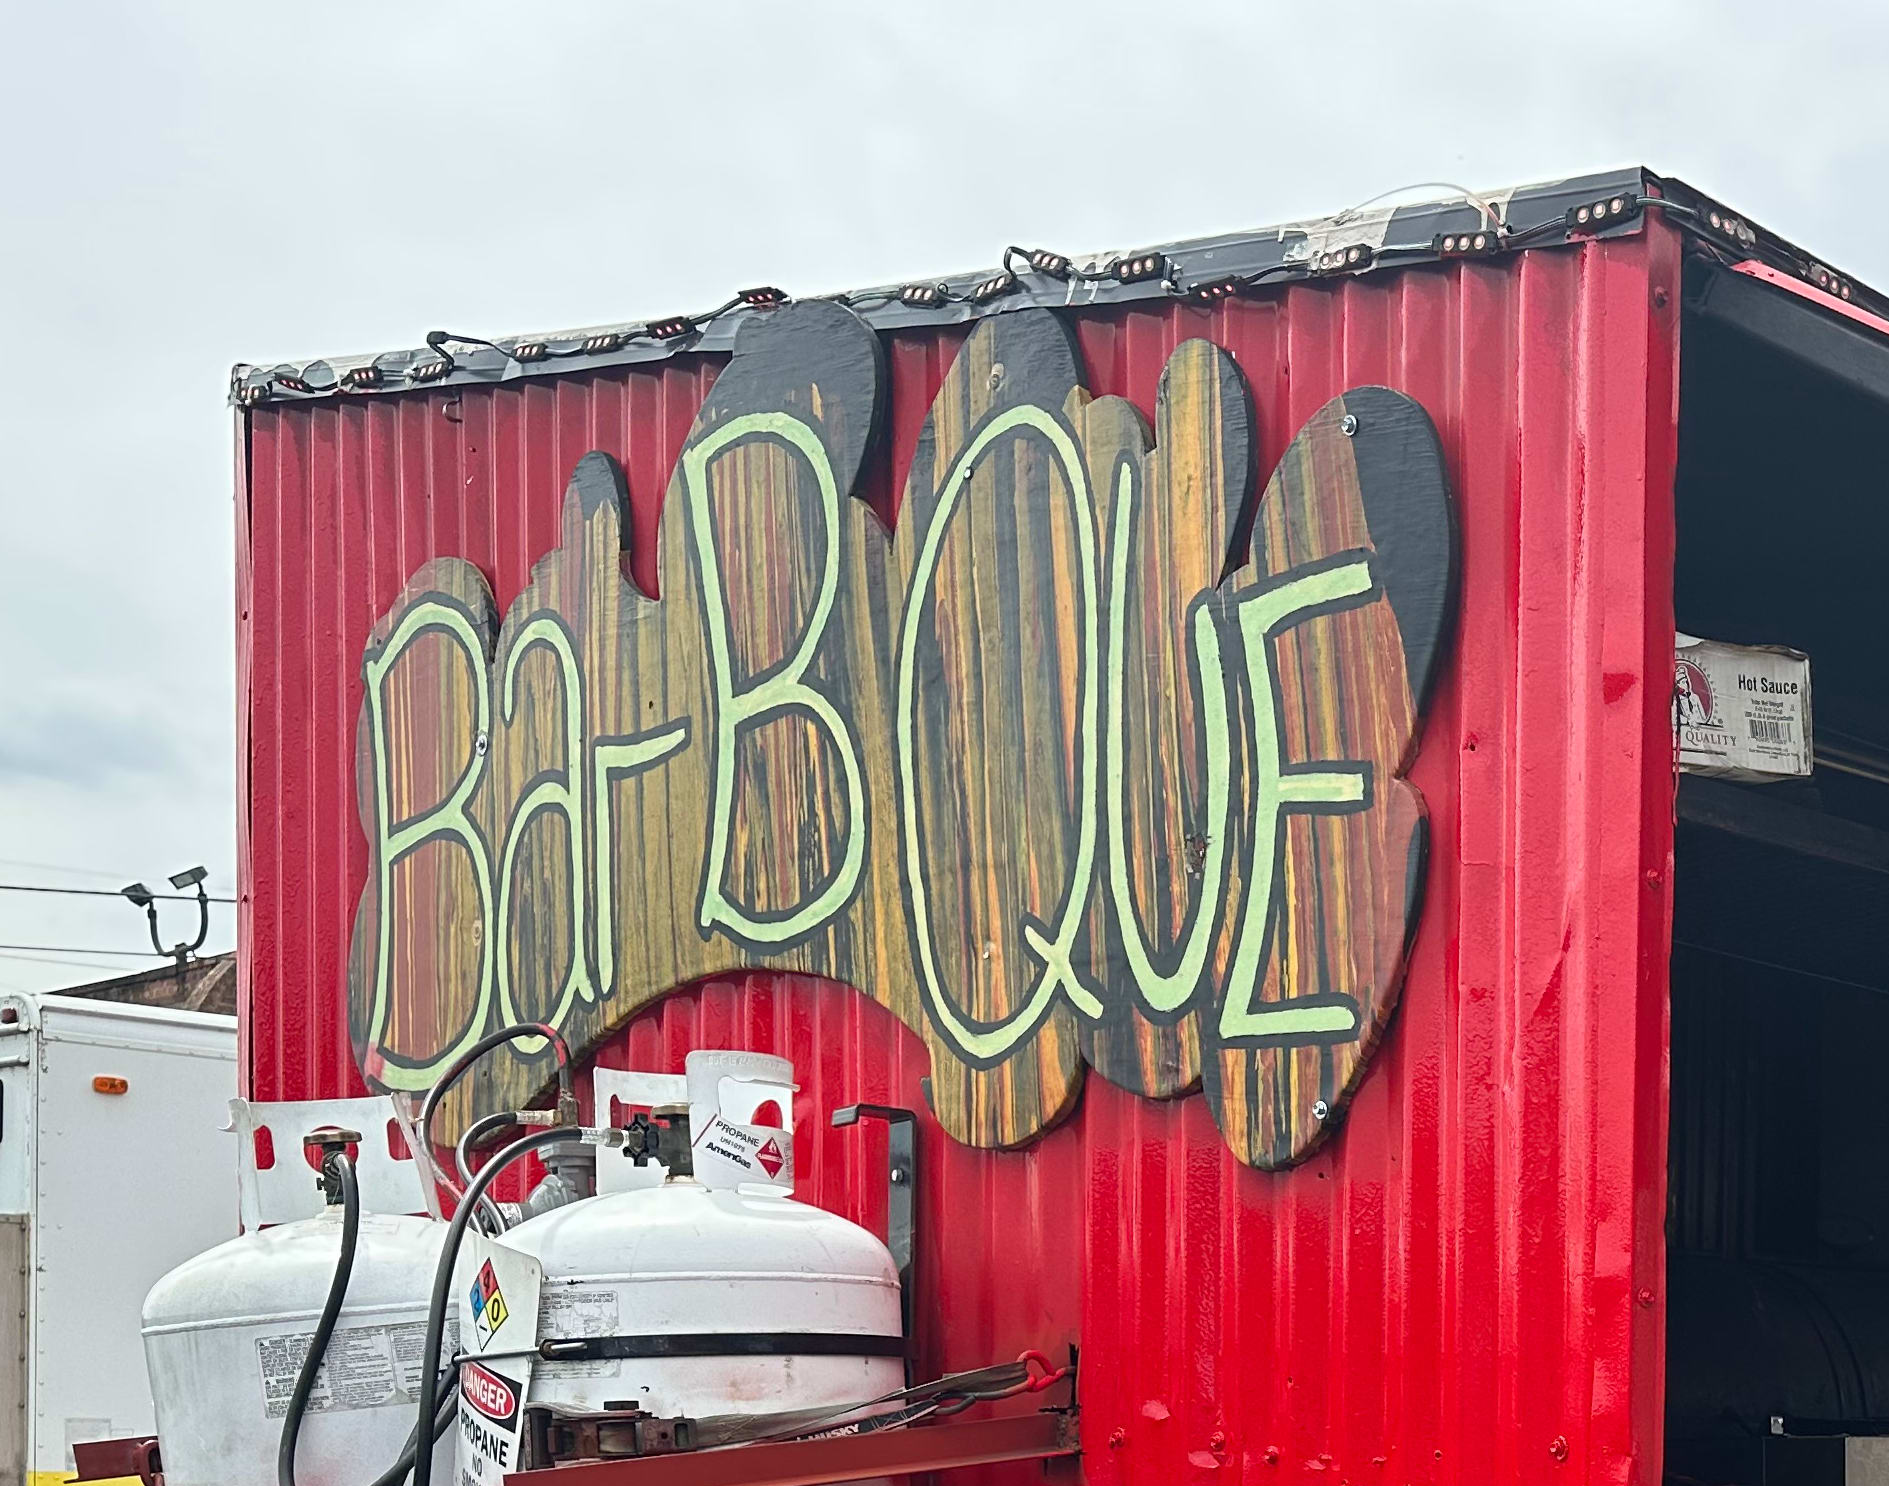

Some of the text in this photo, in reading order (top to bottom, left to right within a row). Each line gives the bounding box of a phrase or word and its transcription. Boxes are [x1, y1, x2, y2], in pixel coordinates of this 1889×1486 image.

[1738, 674, 1798, 695] Hot Sauce
[1686, 730, 1736, 746] QUALITY
[715, 1120, 760, 1147] PROPANE
[483, 1269, 491, 1289] 4
[492, 1298, 500, 1322] 0
[465, 1365, 507, 1415] DANGER
[460, 1407, 509, 1468] PROPANE
[472, 1453, 482, 1476] NO
